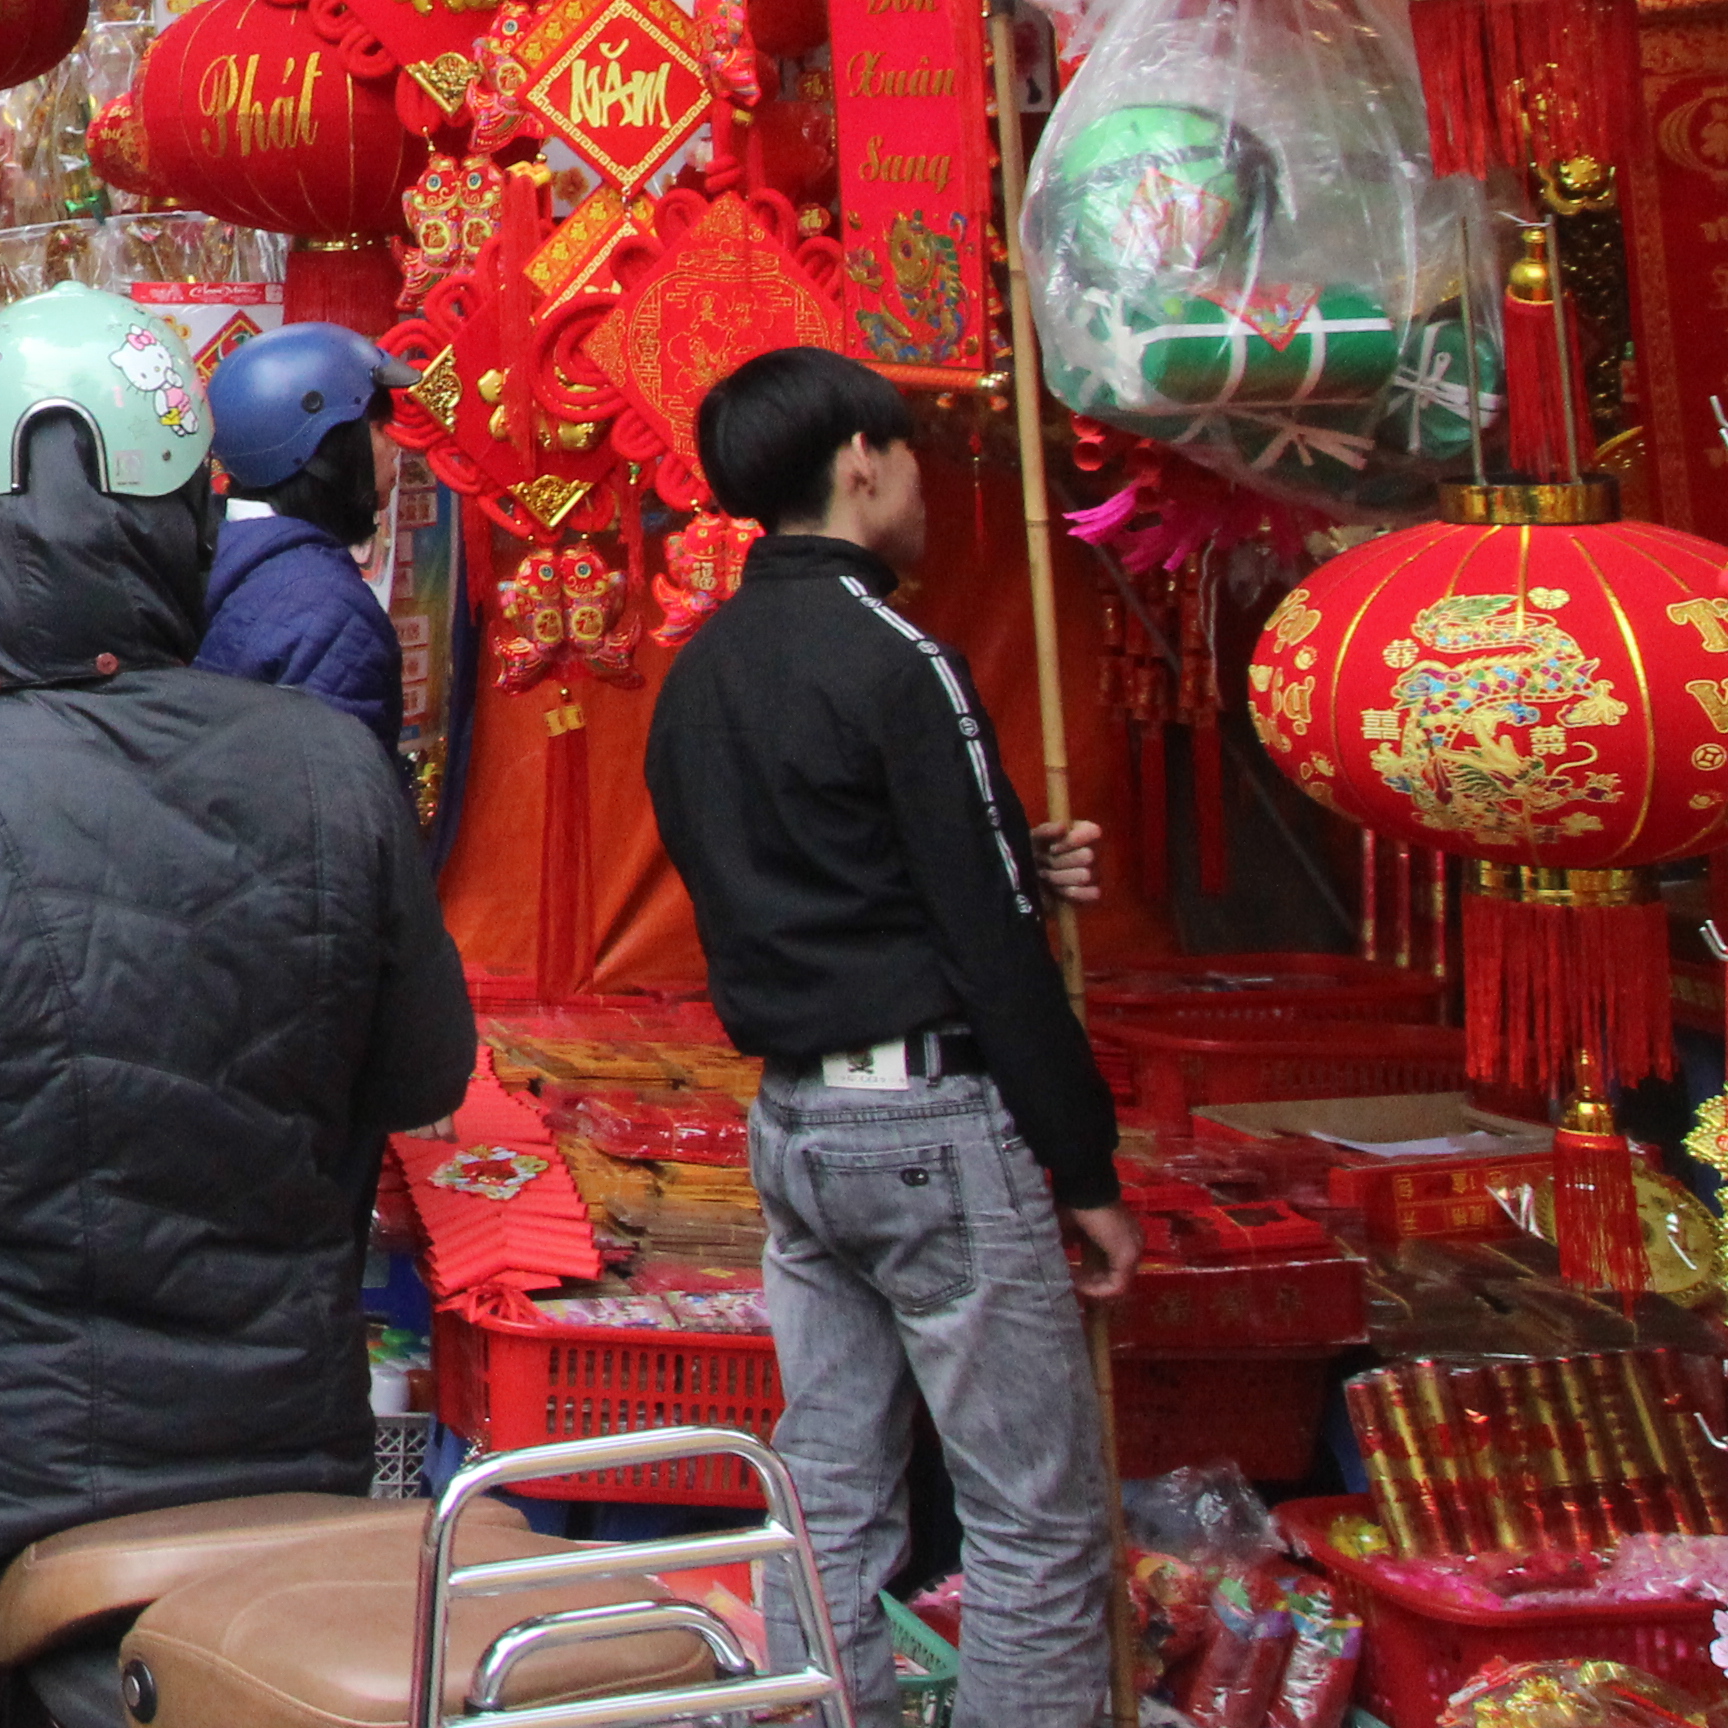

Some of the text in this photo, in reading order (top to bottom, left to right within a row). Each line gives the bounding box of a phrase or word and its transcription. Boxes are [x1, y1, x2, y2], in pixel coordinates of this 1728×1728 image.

[198, 51, 322, 158] Phát
[570, 38, 672, 130] NĂM
[848, 50, 956, 98] Xuân
[858, 135, 954, 195] Sang
